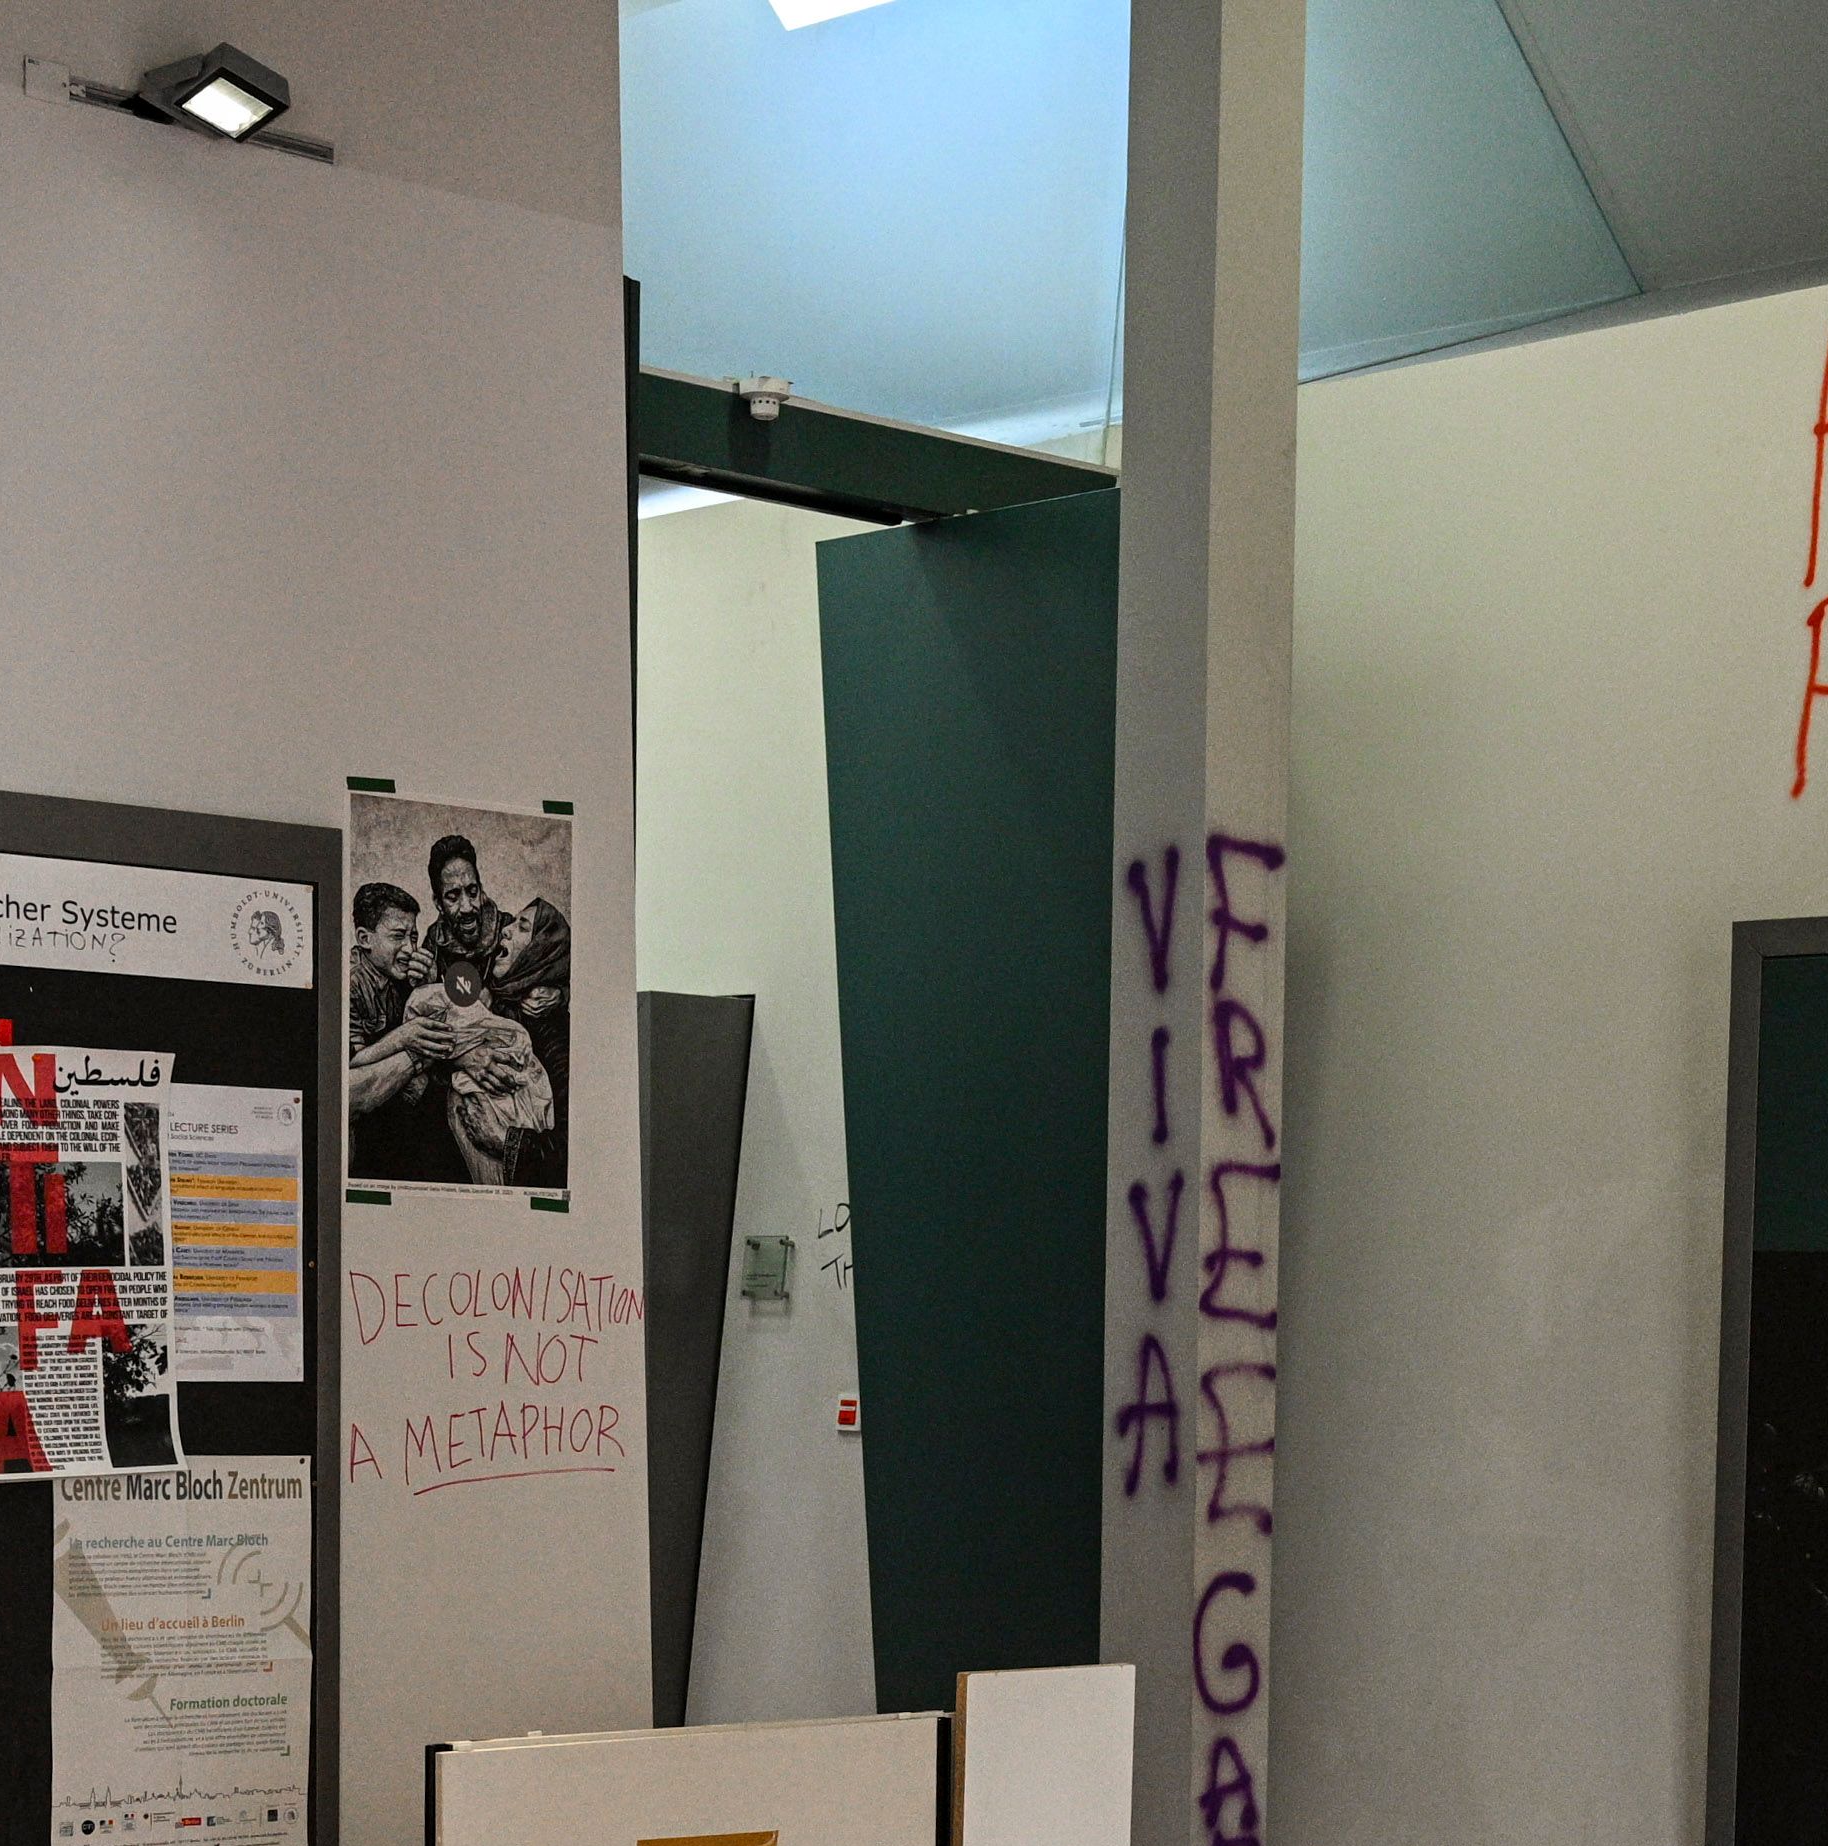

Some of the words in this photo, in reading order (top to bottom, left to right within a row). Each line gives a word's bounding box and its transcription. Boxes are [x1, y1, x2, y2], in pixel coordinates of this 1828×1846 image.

[61, 900, 177, 937] Systeme
[53, 1055, 161, 1096] فلسطين
[93, 1100, 120, 1109] POWERS
[7, 1131, 45, 1140] DEPENDENT
[56, 1132, 67, 1141] THE
[85, 1121, 97, 1130] AND
[102, 1122, 120, 1130] MAKE
[170, 1122, 209, 1133] LECTURE
[212, 1124, 239, 1134] SERIES
[61, 1143, 68, 1152] TO
[70, 1143, 82, 1152] THE
[83, 1143, 97, 1152] WILL
[99, 1143, 107, 1152] OF
[109, 1143, 120, 1152] THE
[1117, 844, 1184, 1499] VIVA
[1198, 832, 1286, 1536] FREE
[349, 1265, 646, 1345] DECOLONISATION
[448, 1331, 487, 1379] IS
[505, 1331, 599, 1386] NOT
[350, 1422, 383, 1483] A
[405, 1400, 626, 1486] METAPHOR
[61, 1477, 121, 1501] Centre
[126, 1474, 171, 1501] Marc
[176, 1469, 222, 1500] Bloch
[227, 1471, 303, 1500] Zentrum
[86, 1536, 145, 1549] recherche
[147, 1538, 162, 1548] au
[165, 1535, 203, 1548] Centre
[206, 1535, 234, 1547] Marc
[122, 1617, 144, 1630] lieu
[211, 1615, 245, 1628] Berlin
[170, 1695, 230, 1711] Formation
[233, 1693, 288, 1707] doctorale
